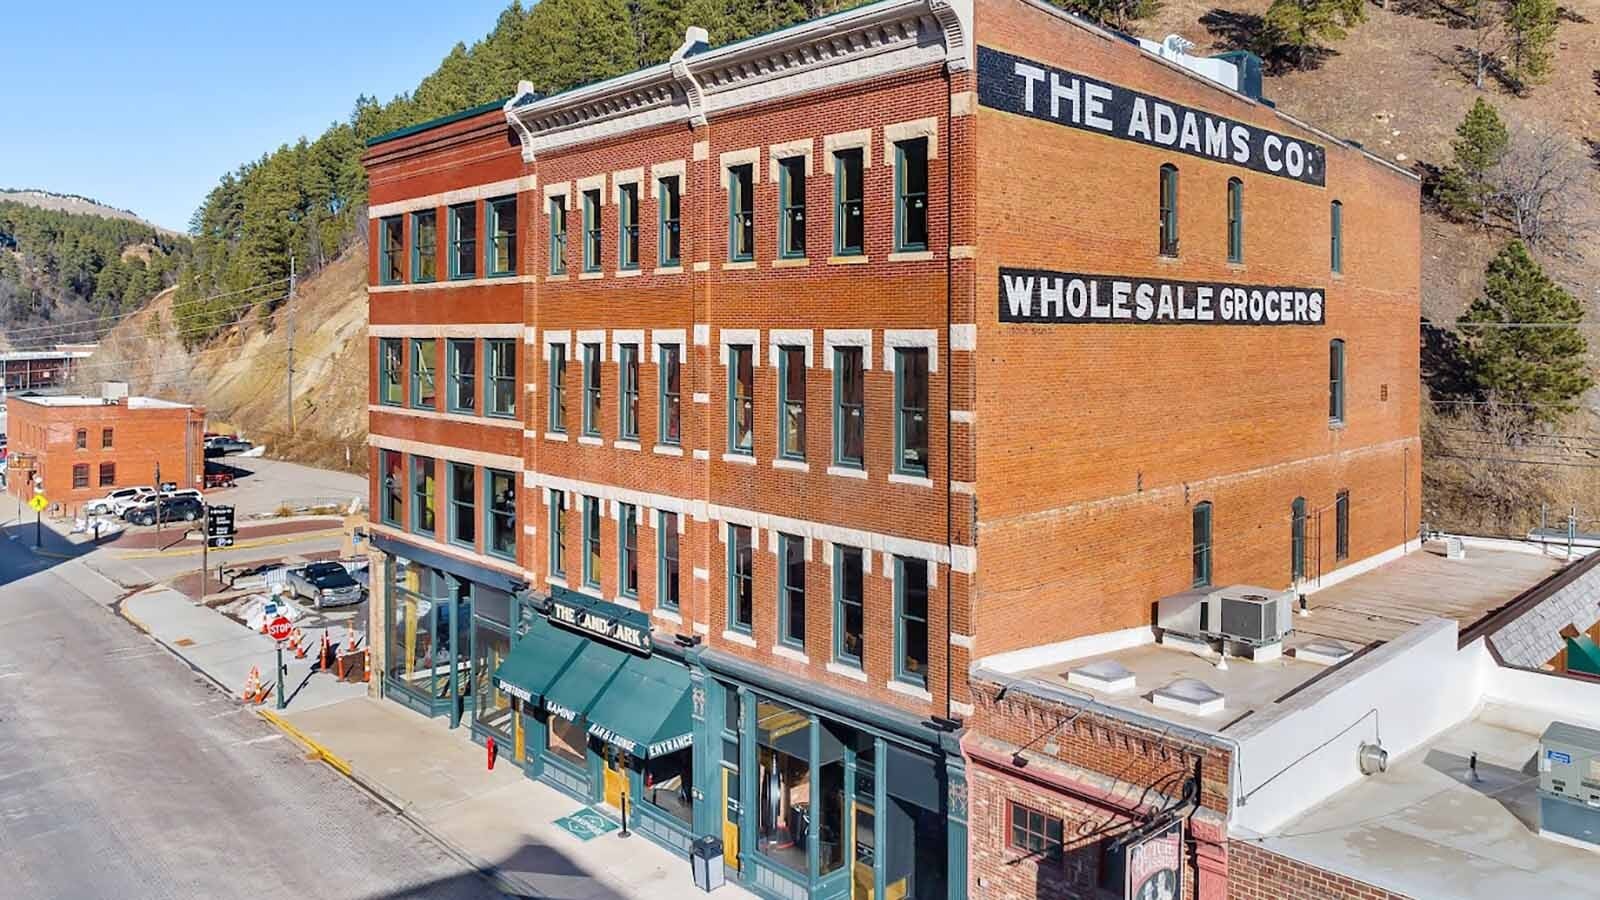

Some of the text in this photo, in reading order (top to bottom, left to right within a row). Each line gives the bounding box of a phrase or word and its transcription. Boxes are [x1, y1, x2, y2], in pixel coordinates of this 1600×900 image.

[1014, 62, 1114, 132] THE
[1128, 97, 1250, 164] ADAMS
[1002, 274, 1323, 322] WHOLESALE GROCERS
[554, 603, 575, 623] THE
[271, 622, 292, 635] STOP
[588, 723, 605, 739] BAR
[649, 733, 694, 757] ENTRANCE
